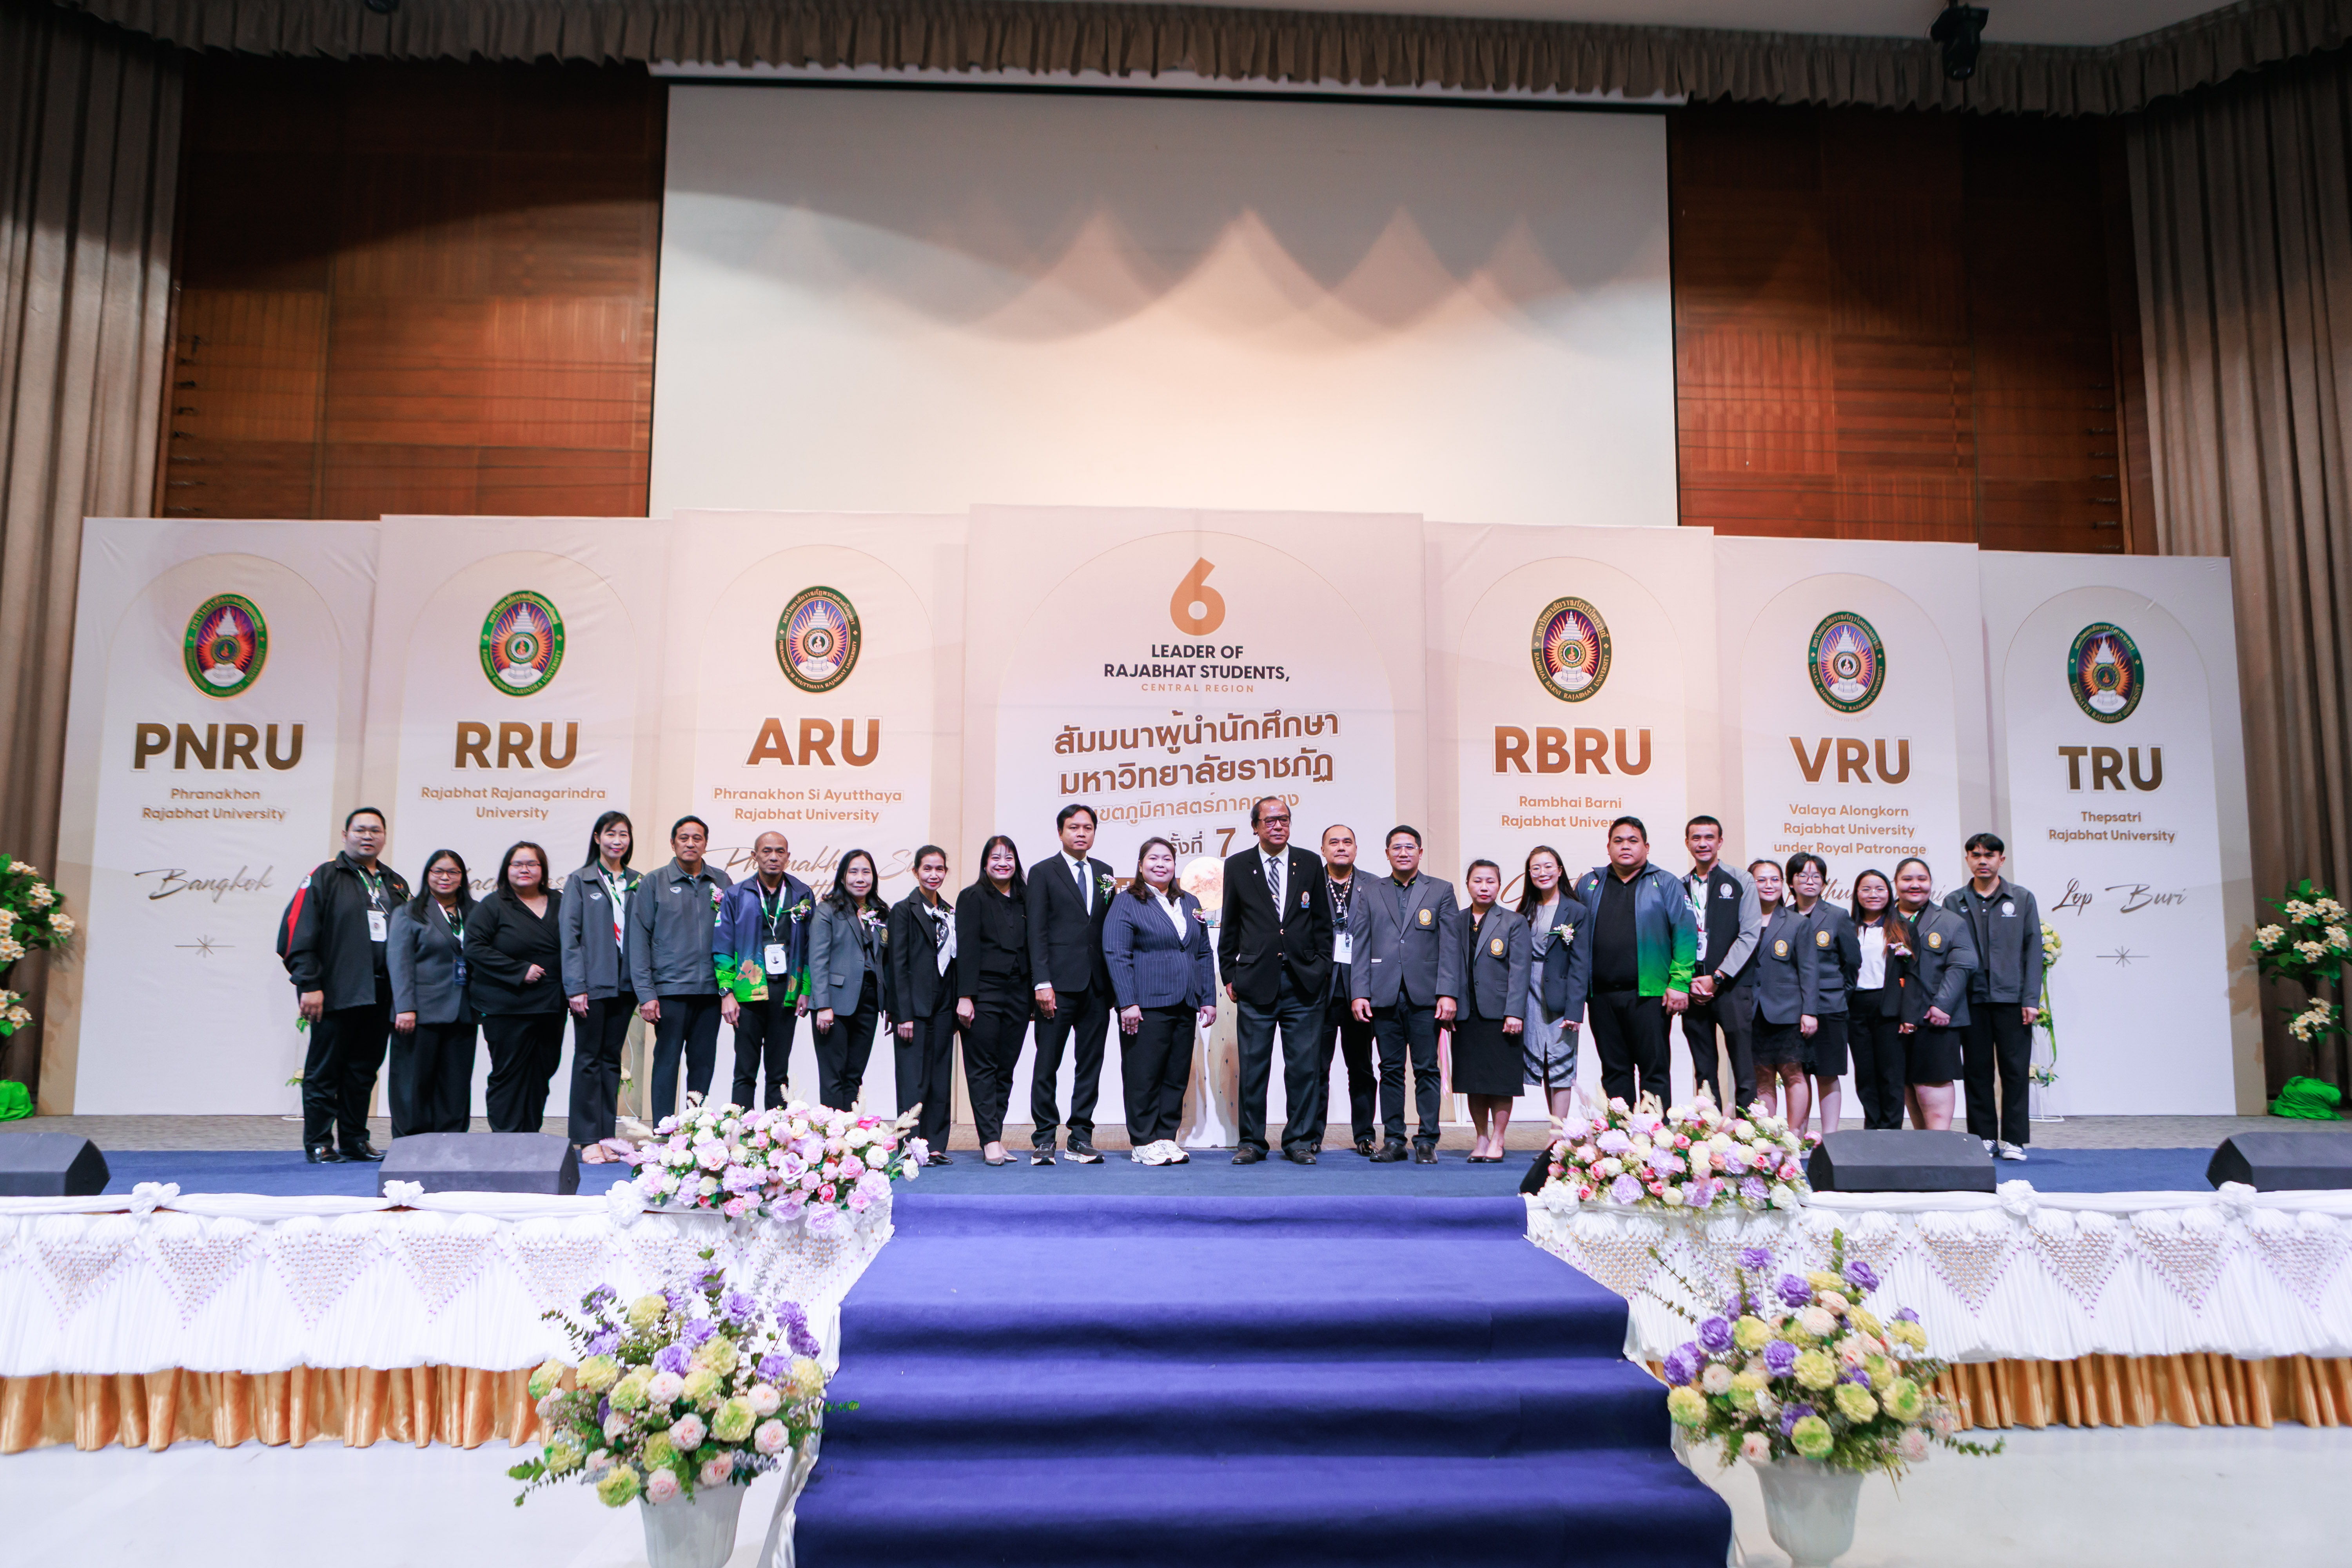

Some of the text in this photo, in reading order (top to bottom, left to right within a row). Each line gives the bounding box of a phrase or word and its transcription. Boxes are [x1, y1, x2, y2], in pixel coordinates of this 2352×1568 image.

[1170, 557, 1226, 636] 6
[1152, 644, 1243, 659] LEADER OF
[794, 677, 824, 689] AYUTTHAYA
[825, 669, 847, 687] RAJABHAT
[845, 641, 857, 669] UNIVERSITY
[1105, 664, 1290, 682] RAJABHAT STUDENTS,
[1534, 652, 1609, 701] RAMBHAI BARNI RAJABHAT UNIVERSITY
[746, 718, 880, 767] ARU
[1055, 709, 1338, 754] สัมมนาผู้นำนักศึกษา
[134, 724, 303, 770] PNRU
[456, 722, 578, 769] RRU
[1495, 726, 1651, 775] RBRU
[1061, 748, 1332, 794] มหาวิทยาลัยราชภัฏ
[1789, 737, 1910, 784] VRU
[2059, 747, 2163, 791] TRU
[171, 789, 260, 800] Phranakhon
[422, 788, 606, 801] Rajabhat Rajanagarindra
[714, 788, 902, 804] Phranakhon Si Ayutthaya
[1520, 796, 1622, 808] Rambhai Barni
[143, 808, 285, 821] Rajabhat University
[477, 808, 548, 821] University
[735, 808, 879, 823] Rajabhat University
[1094, 792, 1299, 824] ขตภูมิศาสตร์ภาคาง
[1790, 804, 1909, 818] Valaya Alongkorn
[2082, 812, 2141, 824] Thepsatri
[1502, 815, 1615, 829] Rajabhat Univer
[1784, 824, 1915, 838] Rajabhat University
[1171, 828, 1236, 857] รั้งที่ 7
[2049, 830, 2175, 843] Rajabhat University
[1774, 842, 1926, 857] under Royal Patronage
[134, 865, 274, 903] Bangkok
[2052, 878, 2187, 916] Lop Buri
